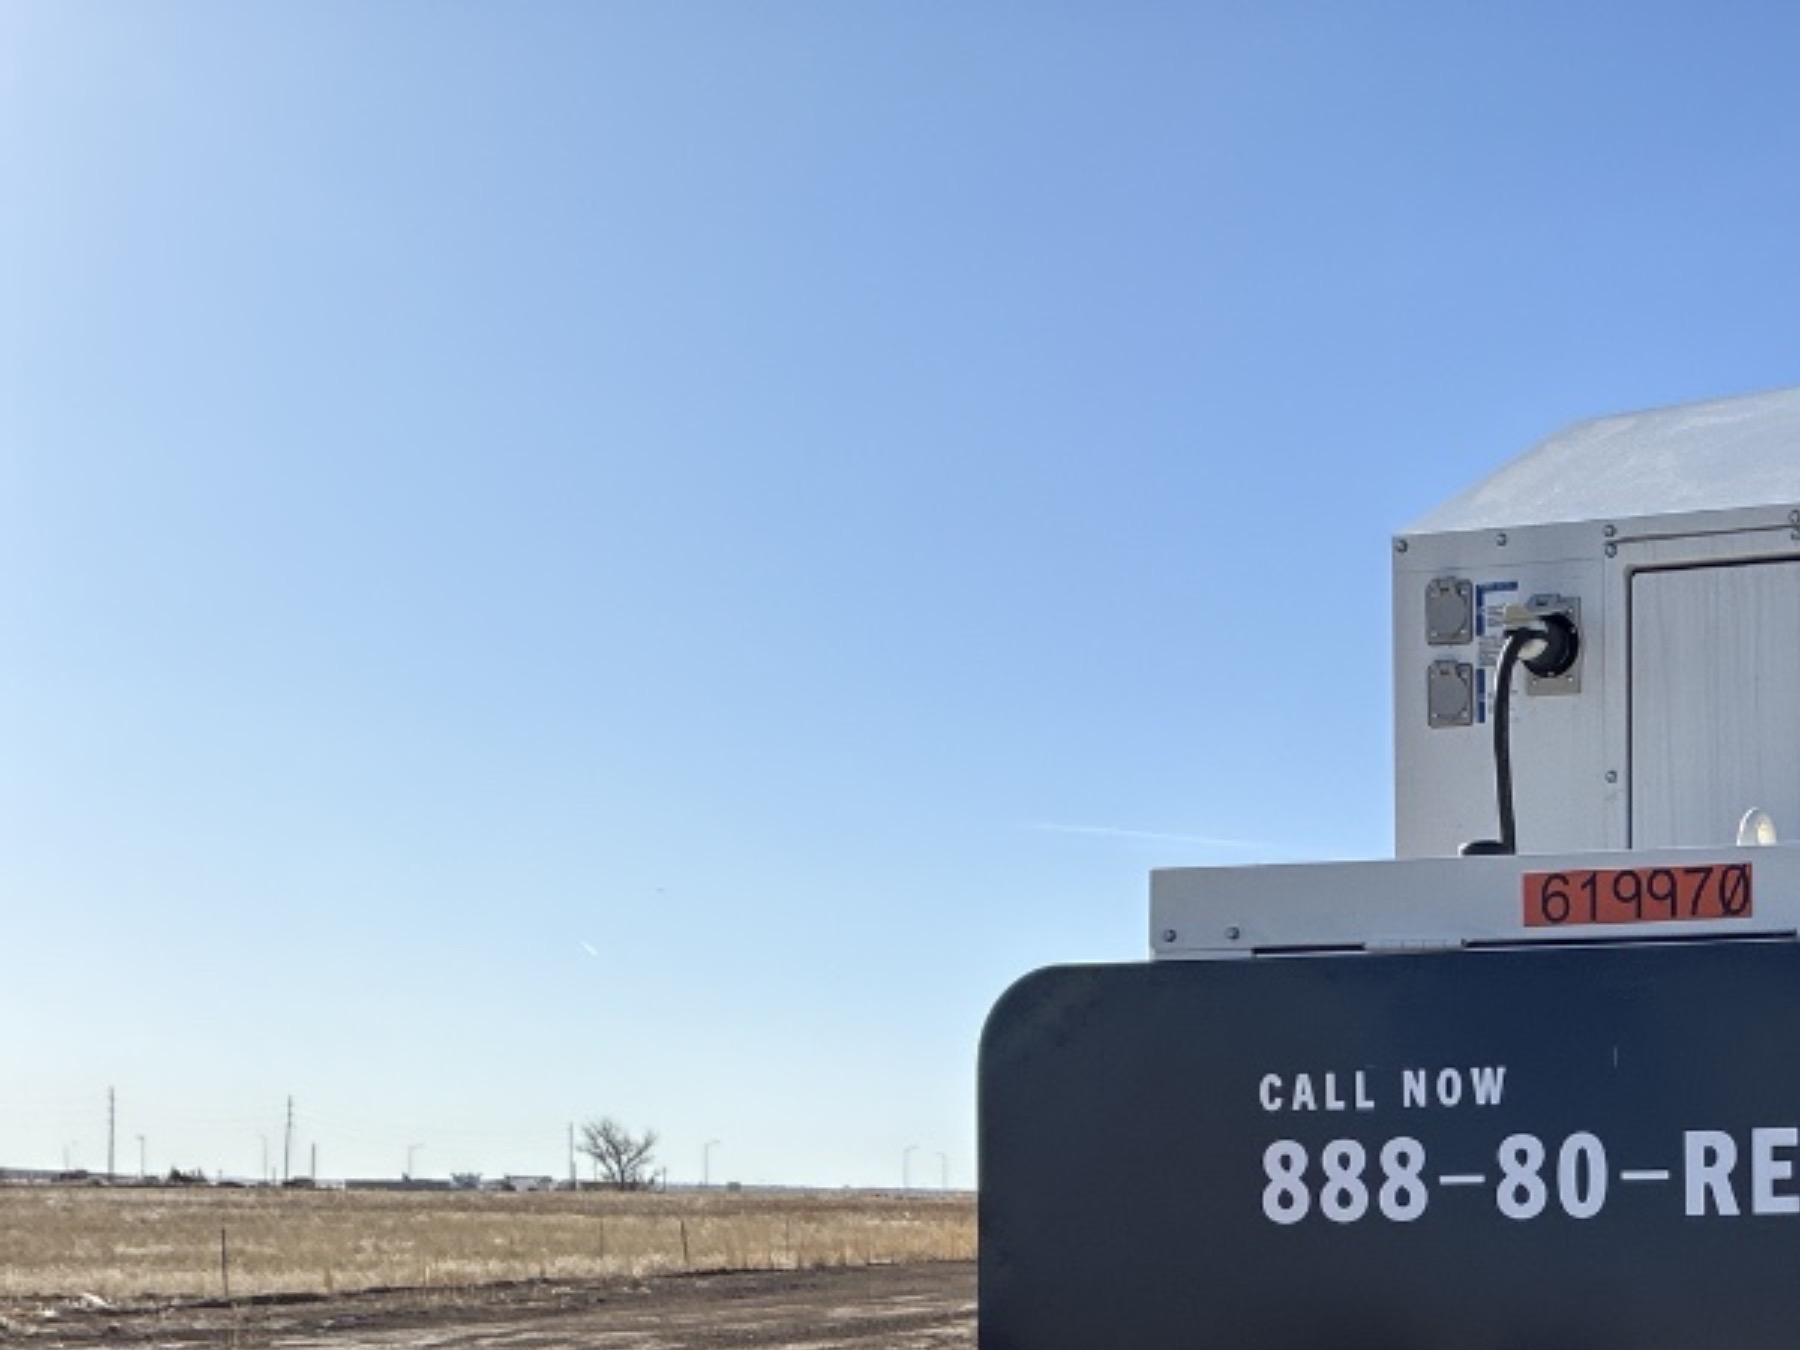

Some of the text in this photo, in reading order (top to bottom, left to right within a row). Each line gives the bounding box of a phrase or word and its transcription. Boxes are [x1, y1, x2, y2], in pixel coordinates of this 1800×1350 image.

[1541, 863, 1750, 924] 619970
[1259, 1066, 1506, 1111] CALL NOW
